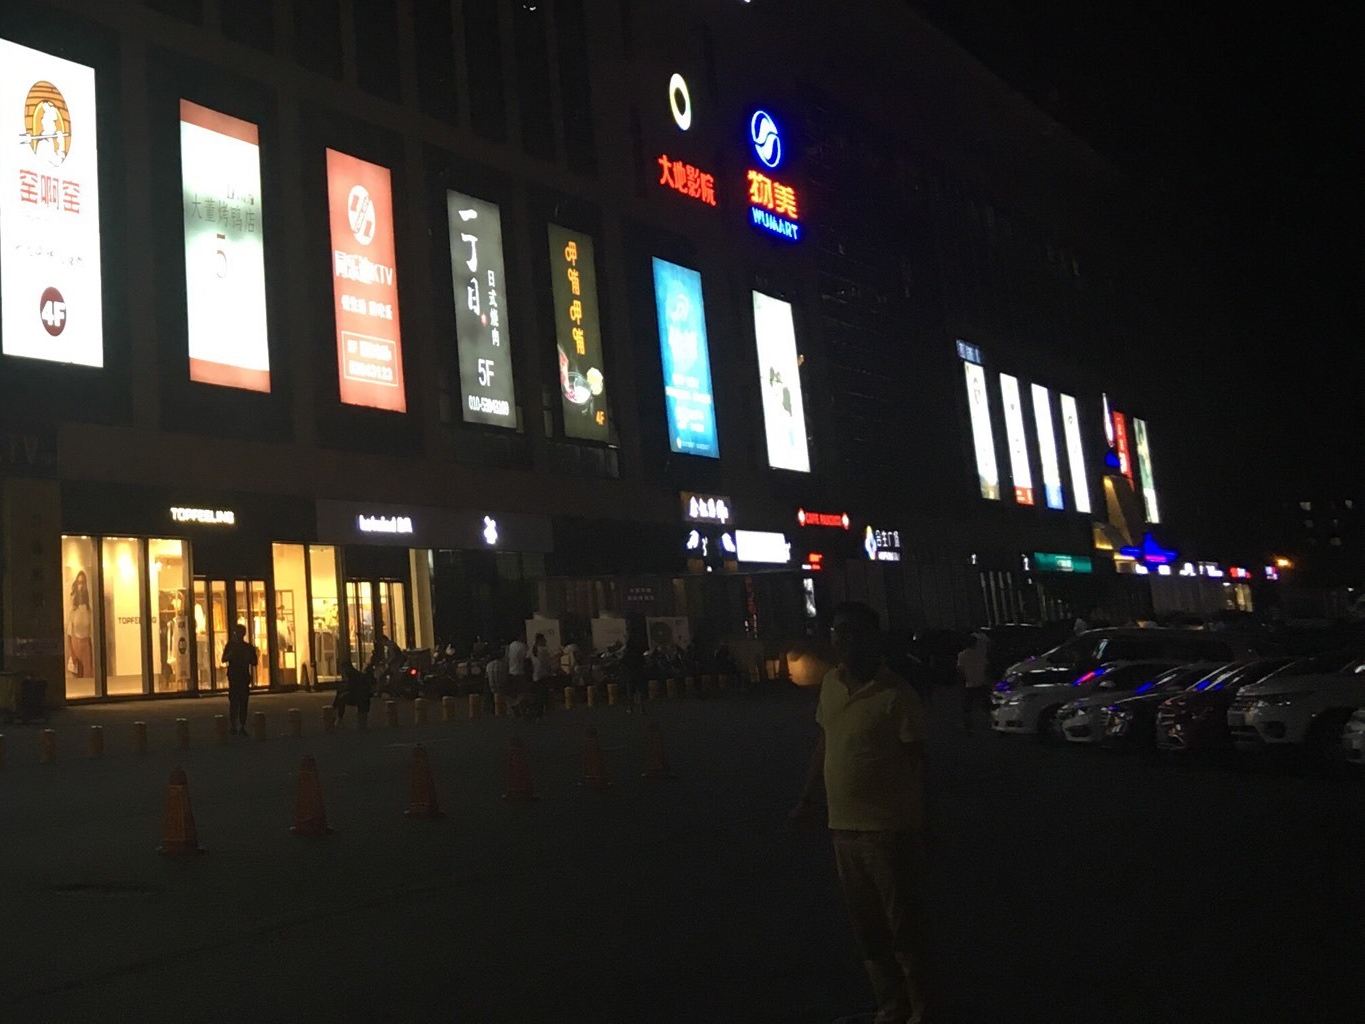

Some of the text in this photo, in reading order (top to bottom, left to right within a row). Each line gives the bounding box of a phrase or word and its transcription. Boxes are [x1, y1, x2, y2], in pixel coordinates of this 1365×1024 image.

[658, 153, 717, 206] 大地影院
[747, 169, 799, 219] 物美
[751, 206, 798, 240] WUMART
[40, 300, 66, 328] 4F
[477, 358, 496, 387] 5F
